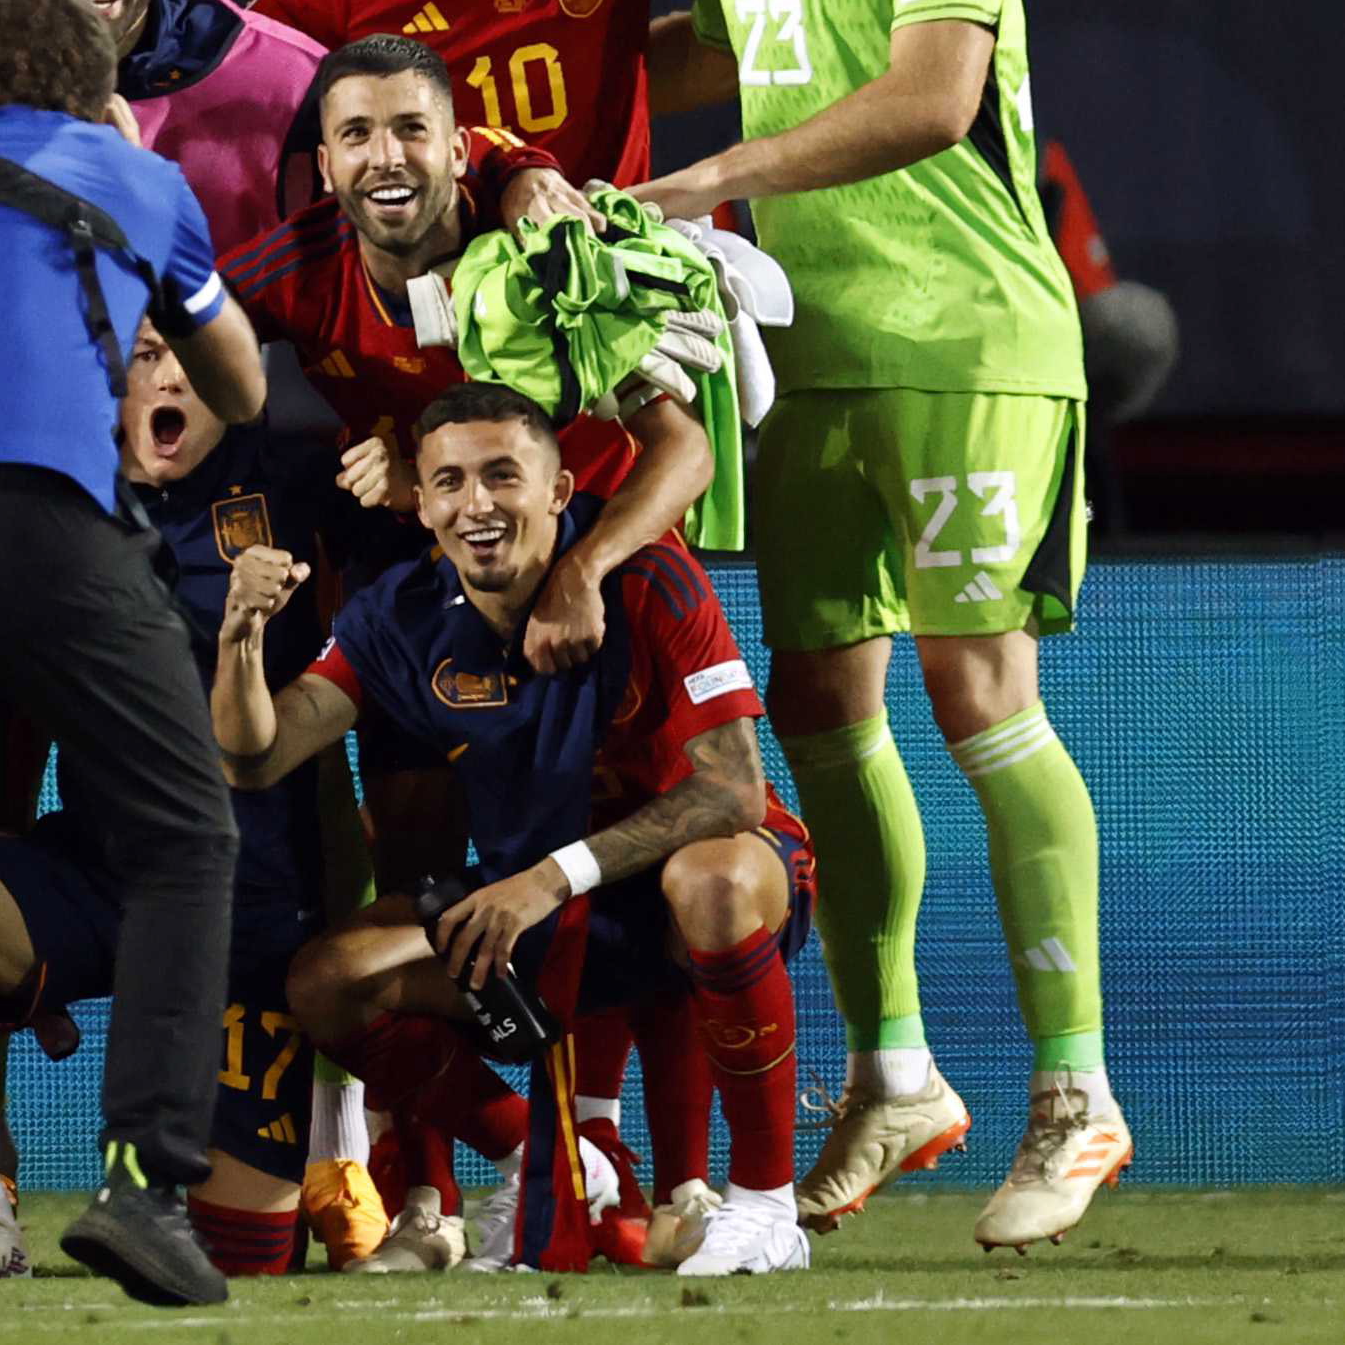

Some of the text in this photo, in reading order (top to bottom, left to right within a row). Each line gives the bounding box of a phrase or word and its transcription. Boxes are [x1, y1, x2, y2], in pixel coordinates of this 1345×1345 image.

[467, 42, 568, 133] 10
[909, 470, 1022, 569] 23
[216, 1001, 303, 1101] 17
